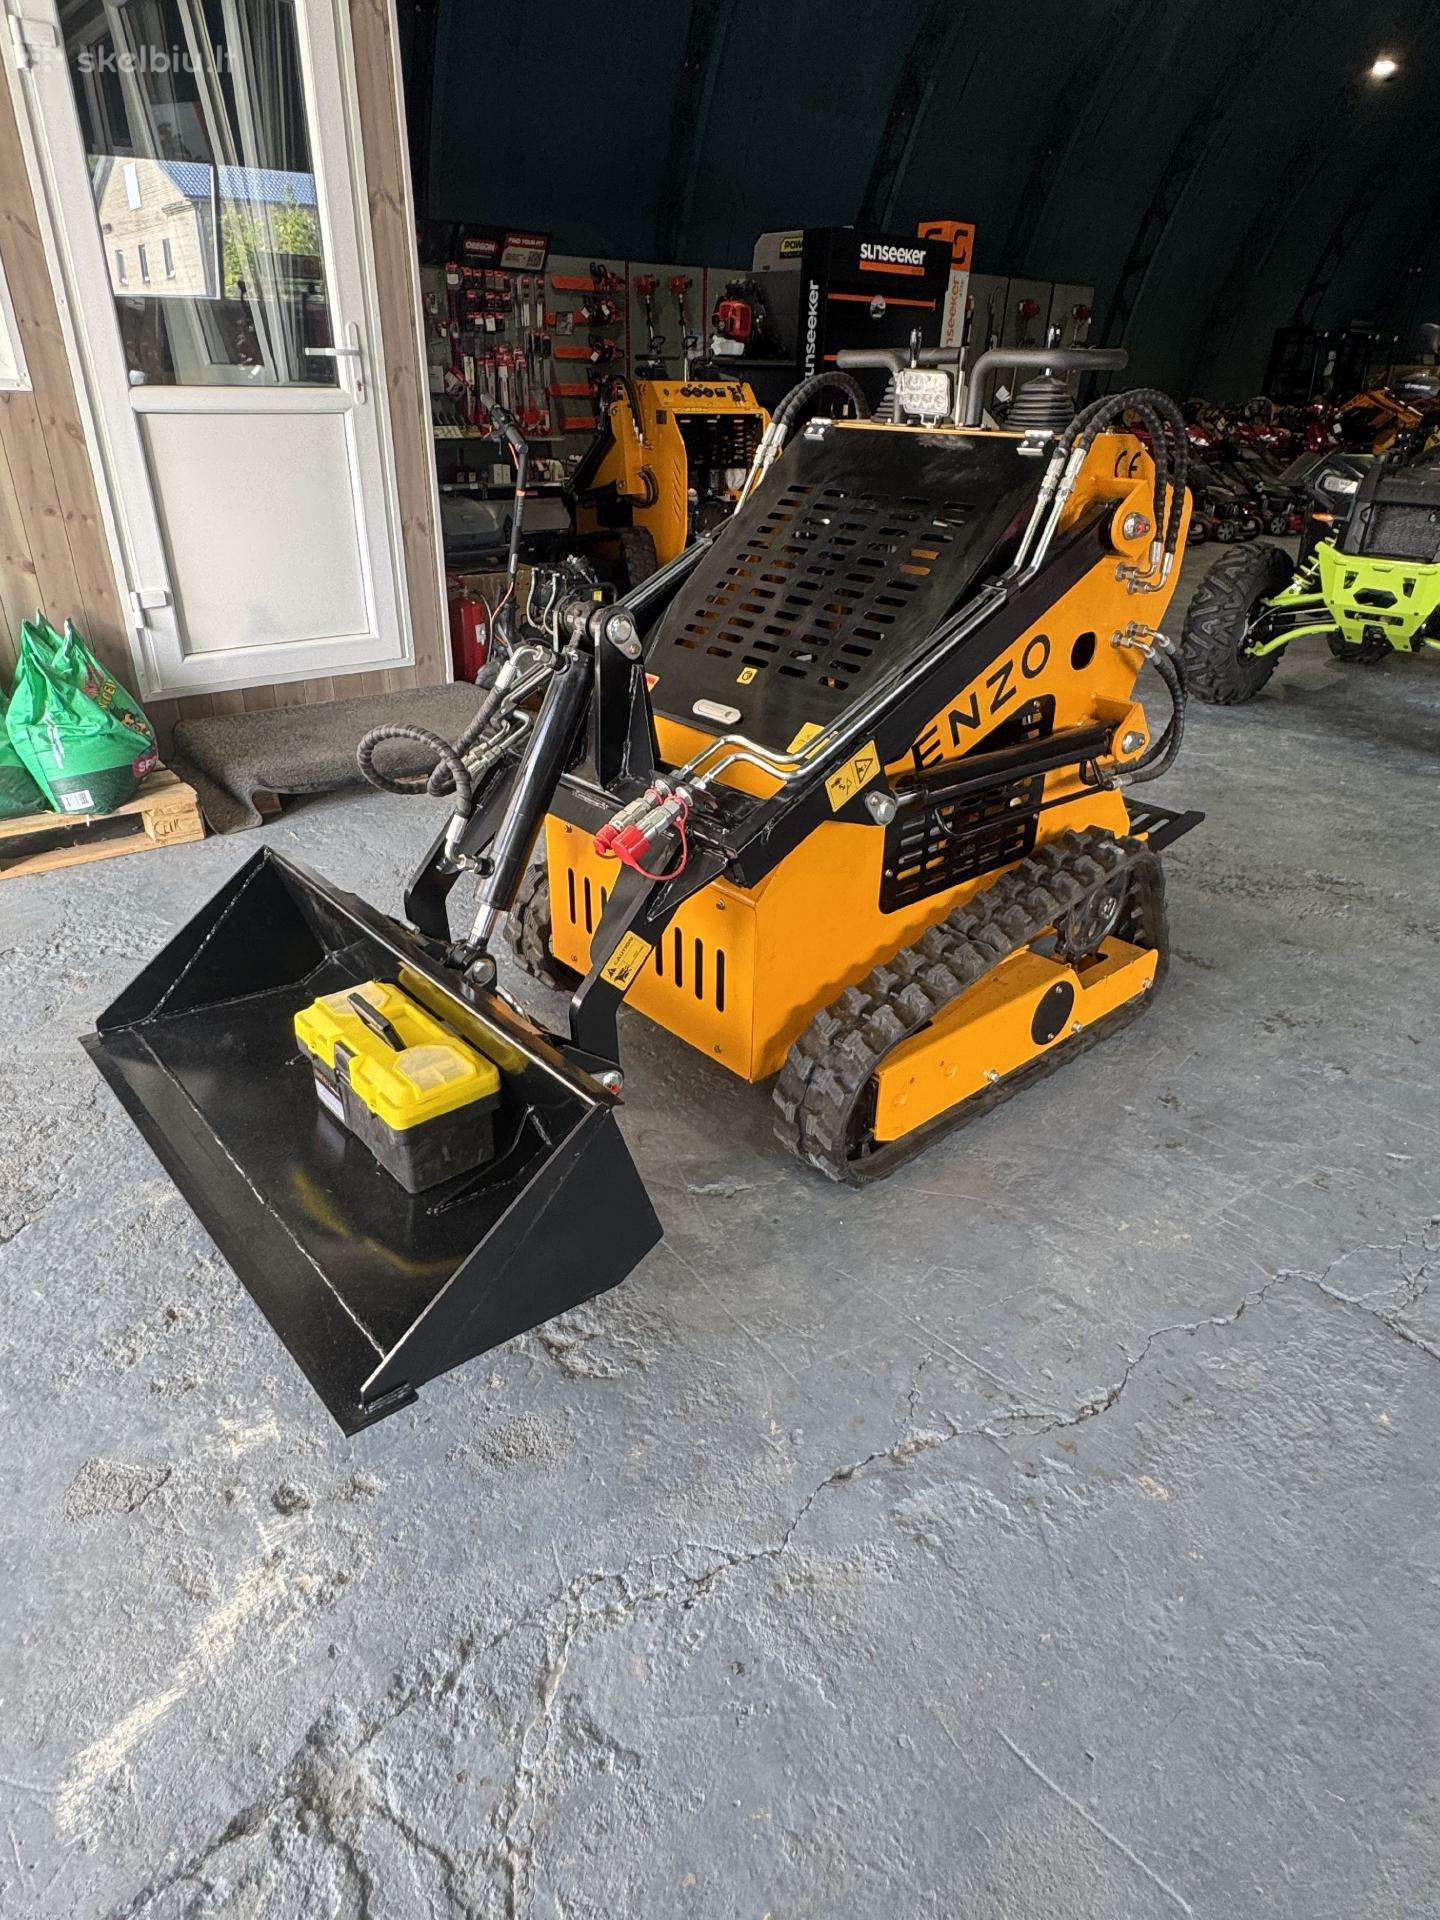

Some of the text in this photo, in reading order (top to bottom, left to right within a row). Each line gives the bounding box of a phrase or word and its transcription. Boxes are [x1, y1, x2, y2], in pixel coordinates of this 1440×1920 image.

[859, 242, 927, 266] sunseeker
[804, 279, 819, 379] unseeker
[911, 634, 1051, 772] ENZO
